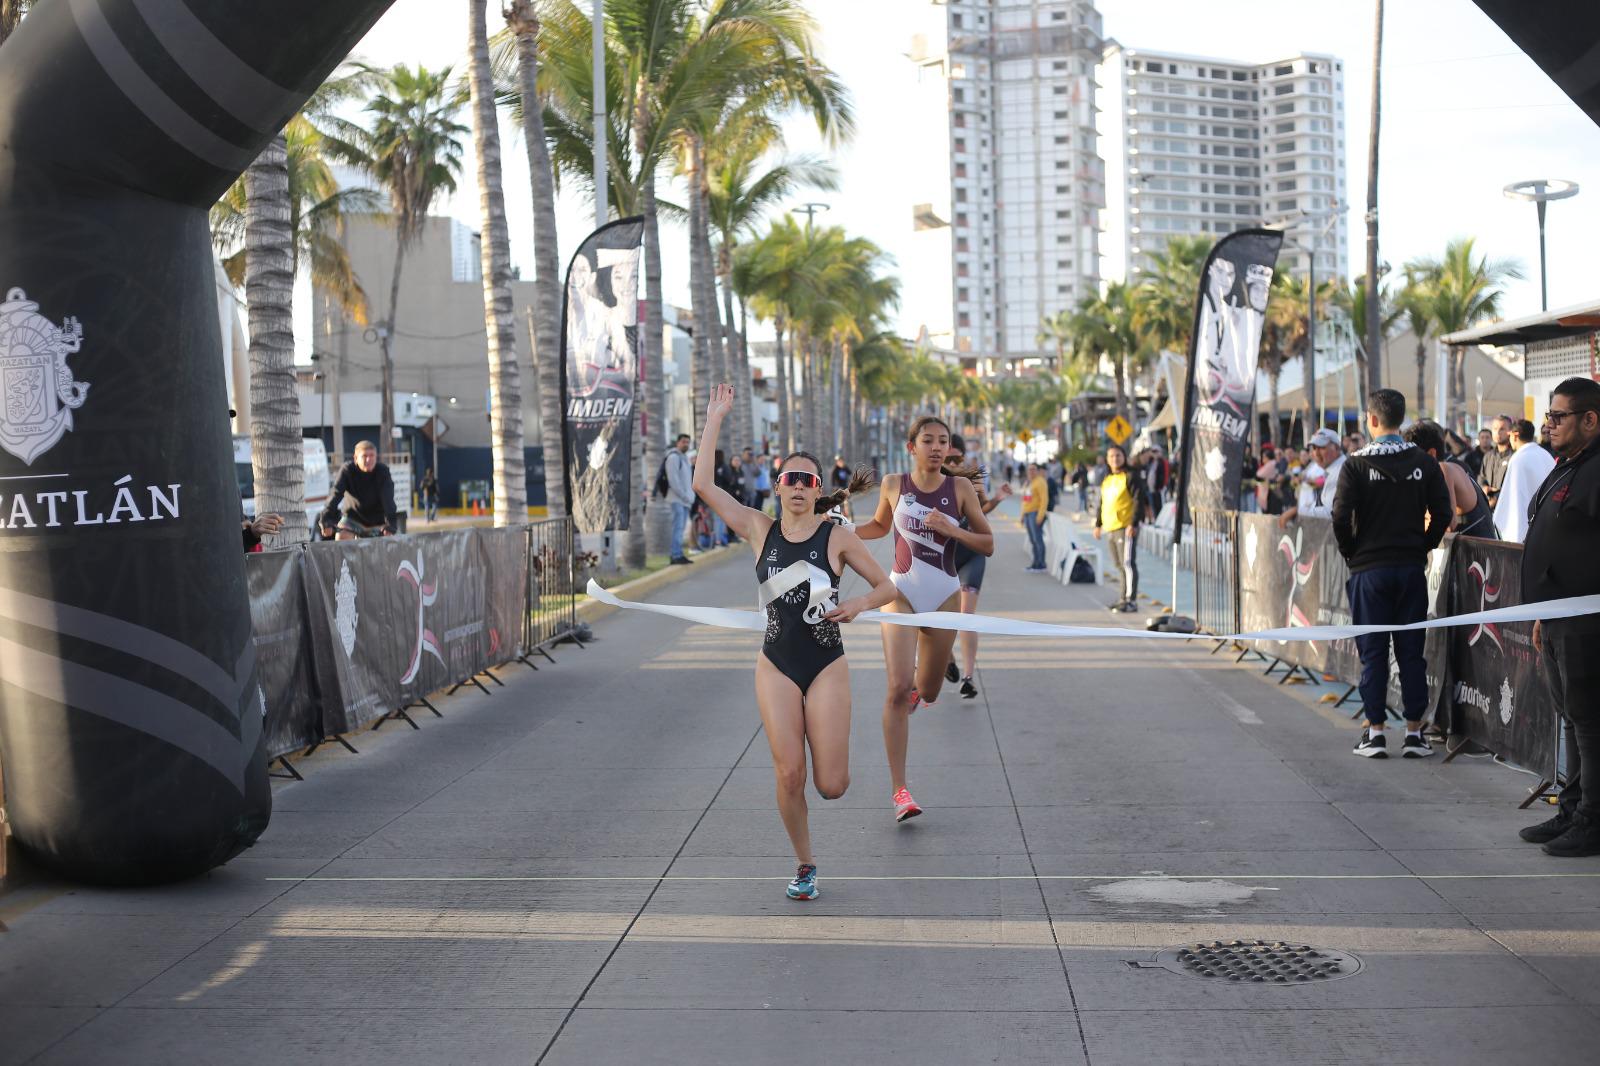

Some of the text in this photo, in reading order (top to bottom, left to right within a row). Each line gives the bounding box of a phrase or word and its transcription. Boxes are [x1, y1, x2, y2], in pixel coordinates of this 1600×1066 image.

[567, 398, 633, 418] IMDEM
[1191, 406, 1248, 438] IMDEM
[0, 474, 181, 529] ATLÁN
